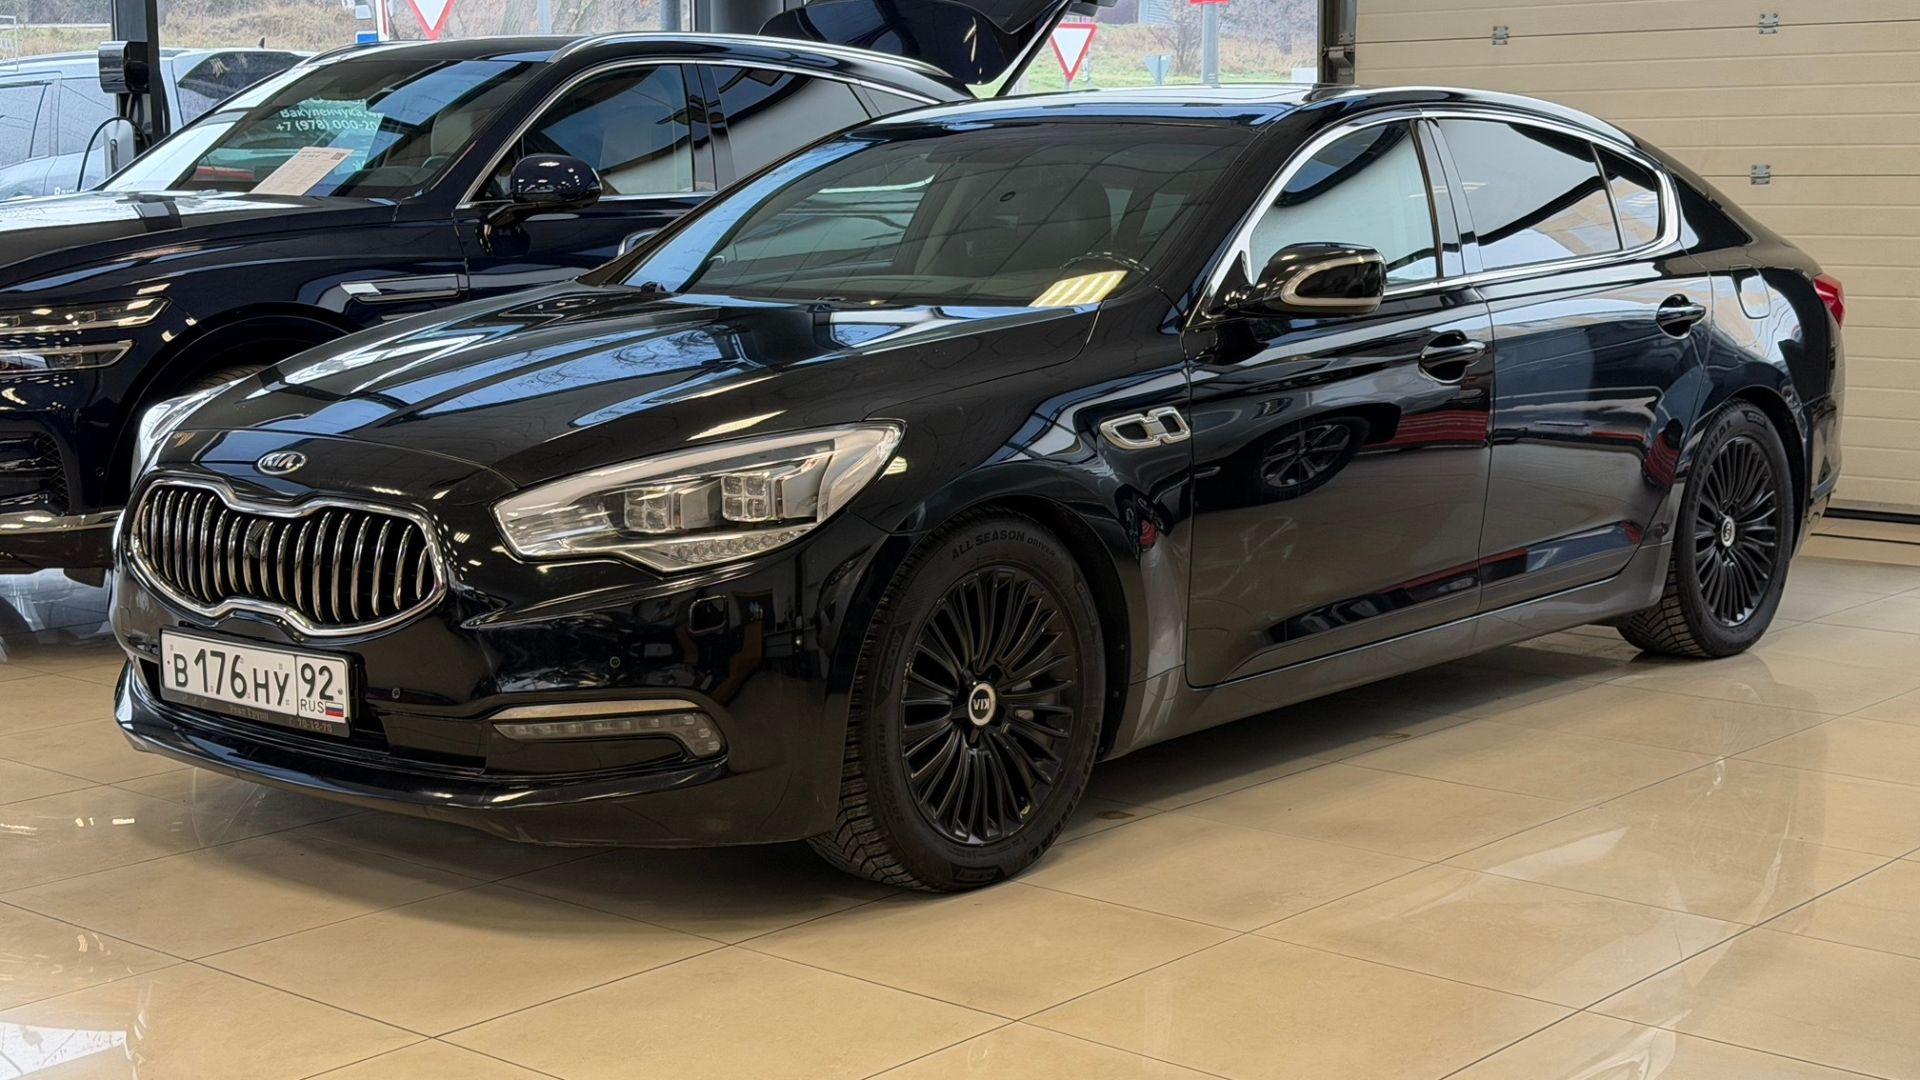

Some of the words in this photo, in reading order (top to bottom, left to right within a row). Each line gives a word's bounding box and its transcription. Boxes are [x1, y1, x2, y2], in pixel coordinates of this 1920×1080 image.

[275, 121, 292, 132] +7
[294, 119, 330, 133] (978)
[261, 453, 298, 469] KIA
[951, 540, 974, 560] ALL
[975, 529, 1026, 546] SEASON
[300, 662, 335, 701] 92
[300, 699, 325, 713] RUS
